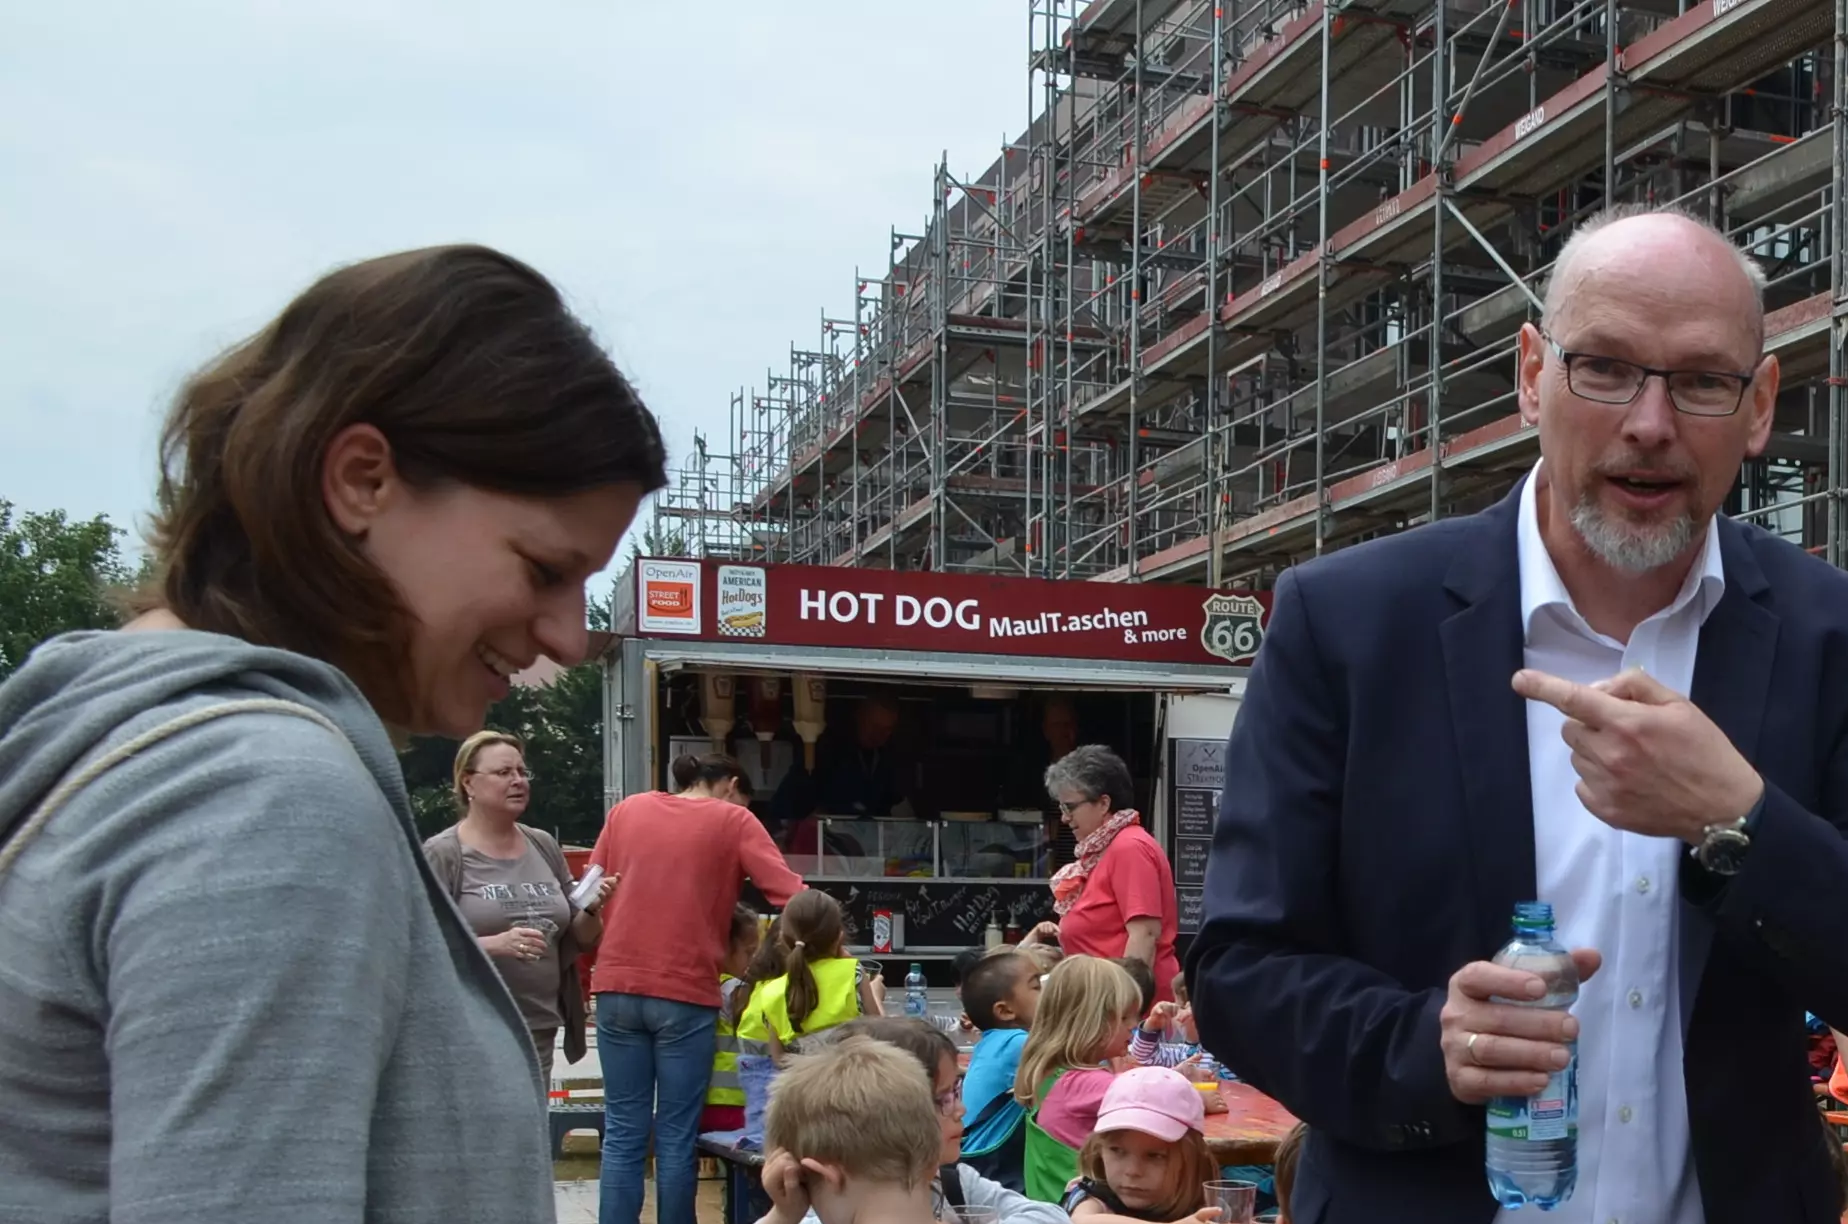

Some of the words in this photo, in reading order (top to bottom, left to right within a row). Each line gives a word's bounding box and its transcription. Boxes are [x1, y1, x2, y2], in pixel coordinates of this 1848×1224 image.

[646, 566, 693, 579] OpenAir
[722, 576, 762, 587] AMERICAN
[649, 590, 680, 599] STREET
[651, 599, 680, 607] FOOD
[800, 589, 884, 624] HOT
[896, 595, 980, 631] DOG
[1212, 600, 1255, 615] ROUTE
[989, 608, 1148, 638] MaulT.aschen
[1124, 629, 1138, 644] &
[1141, 628, 1187, 643] more
[1212, 620, 1255, 651] 66
